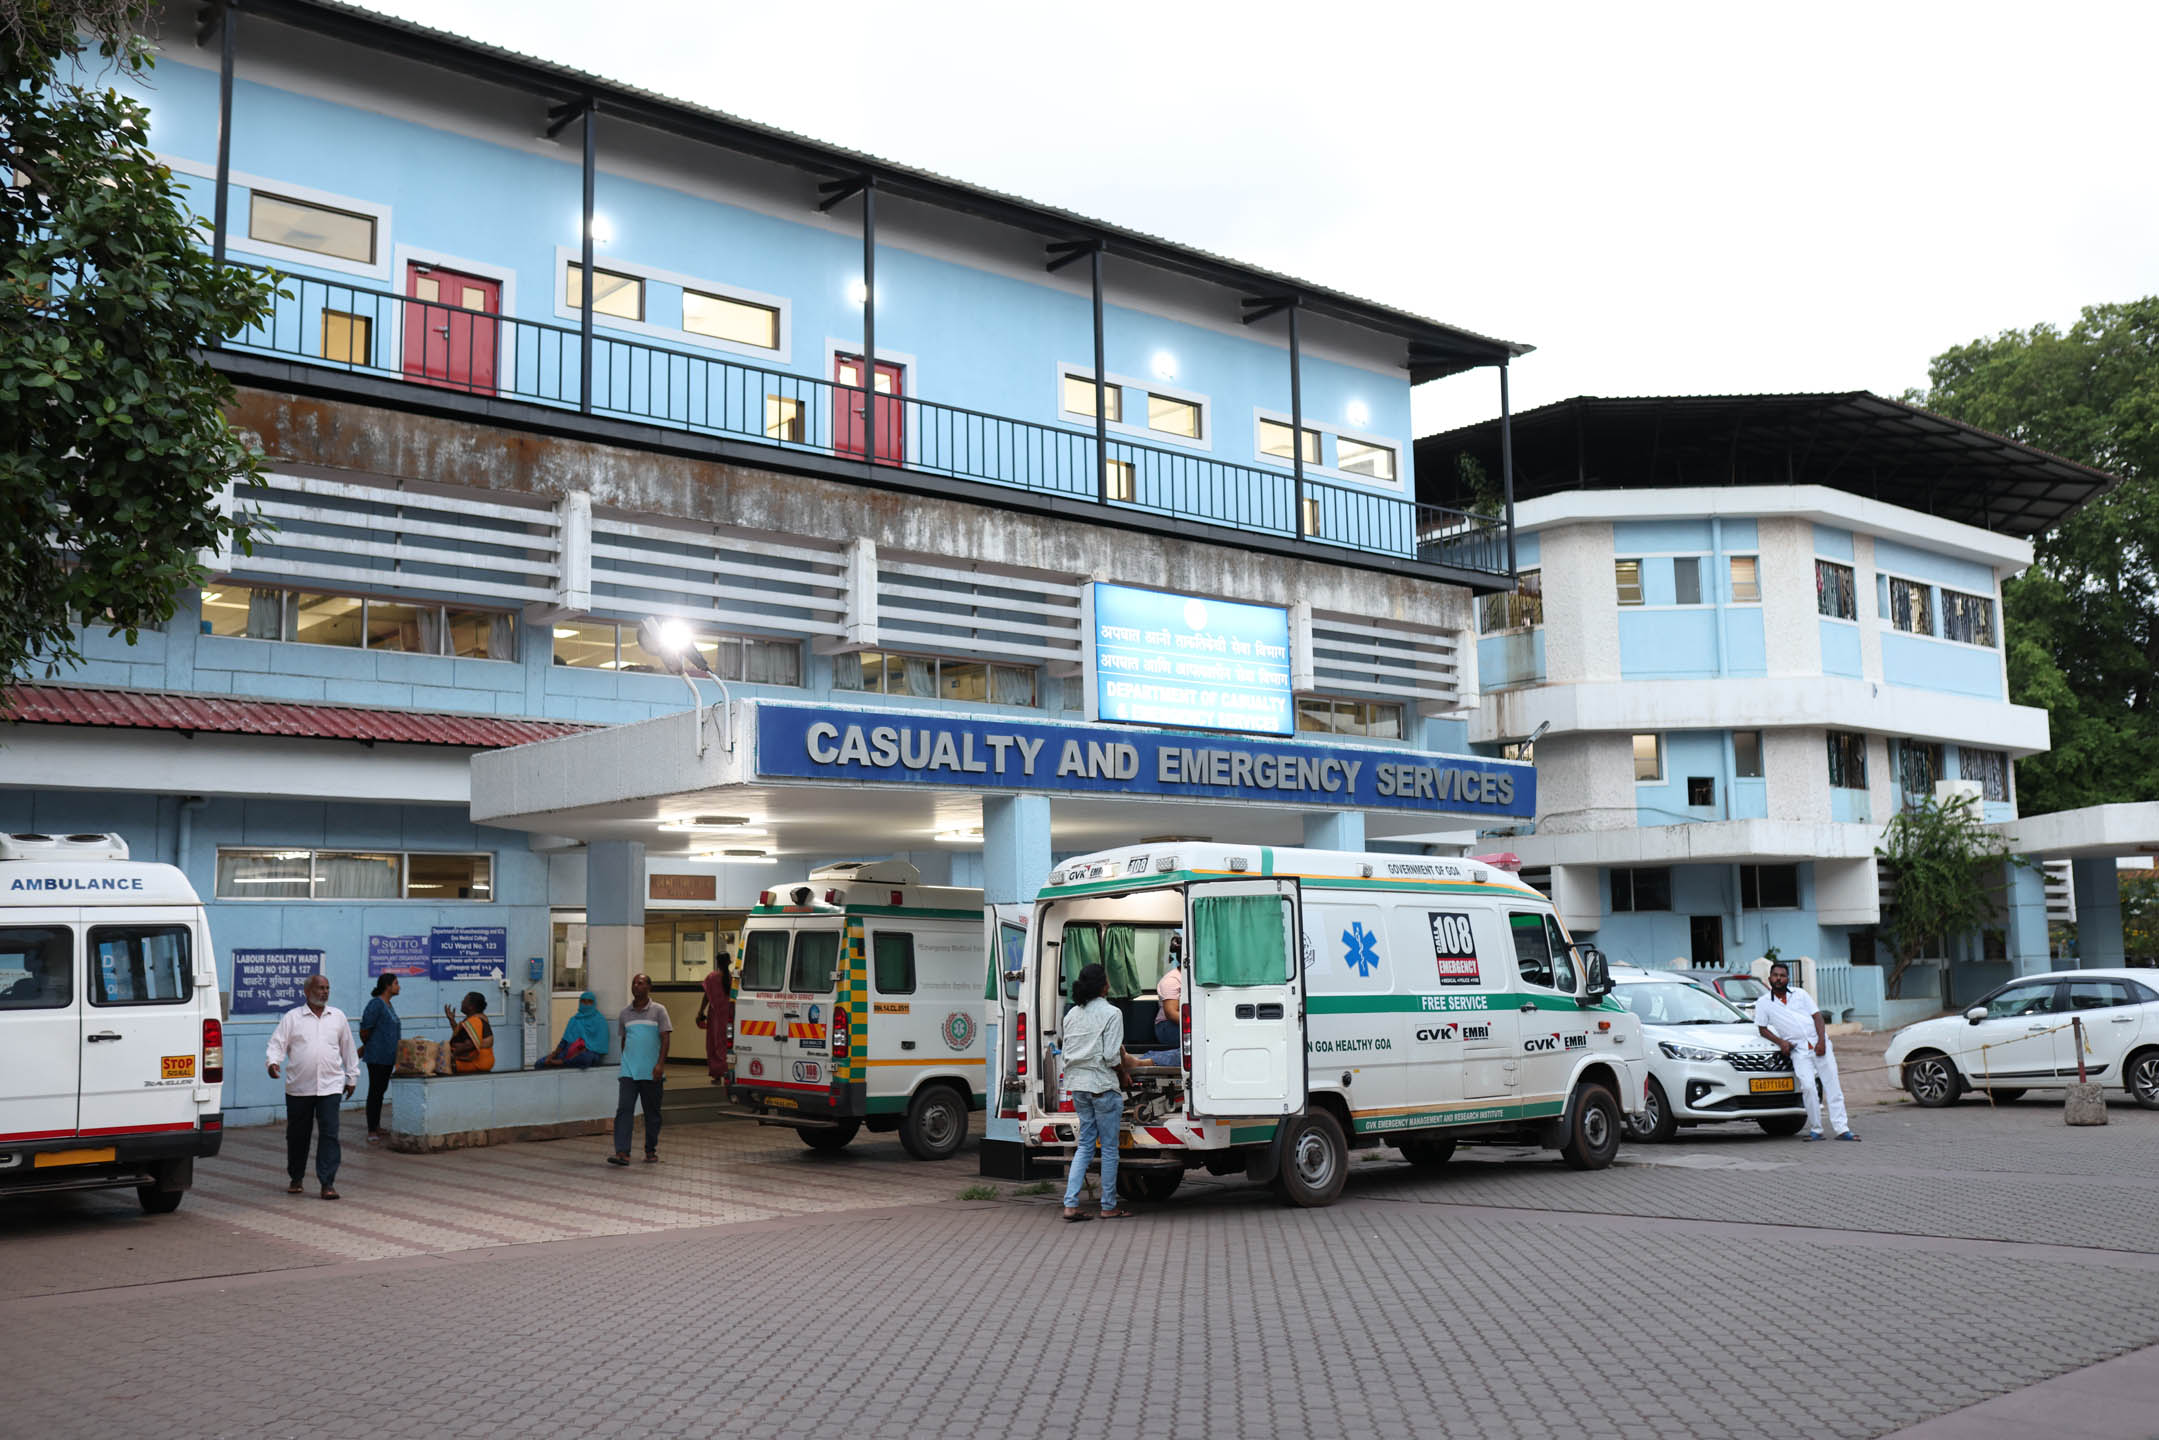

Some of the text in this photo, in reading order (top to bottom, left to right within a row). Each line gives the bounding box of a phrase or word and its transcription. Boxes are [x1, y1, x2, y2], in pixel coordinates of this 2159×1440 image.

[1106, 681, 1285, 713] DEPARTMENT OF CASUALTY
[806, 721, 1514, 805] CASUALTY AND EMERGENCY SERVICES
[1130, 859, 1148, 873] 108
[1387, 863, 1461, 876] GOVERNMENT OF GOA
[1069, 869, 1087, 881] GVK
[11, 878, 143, 891] AMBULANCE
[1433, 916, 1474, 955] 108
[382, 939, 418, 949] SOTTO
[236, 954, 319, 964] LABOUR FACILITY WARD
[243, 965, 264, 974] WARD
[265, 965, 276, 974] NO
[277, 965, 290, 974] 126
[298, 965, 311, 974] 127
[1438, 960, 1477, 974] EMERGENCY
[1421, 995, 1488, 1010] FREE SERVICE
[1416, 1026, 1489, 1041] GVK EMRI
[1315, 1041, 1333, 1052] GOA
[1335, 1039, 1372, 1051] HEALTHY
[1375, 1038, 1392, 1050] GOA
[1523, 1035, 1587, 1052] GVK EMRI
[163, 1058, 193, 1070] STOP
[1365, 1109, 1504, 1130] GVK EMERGENCY MANAGEMENT AND RESEARCH INSTITUTE
